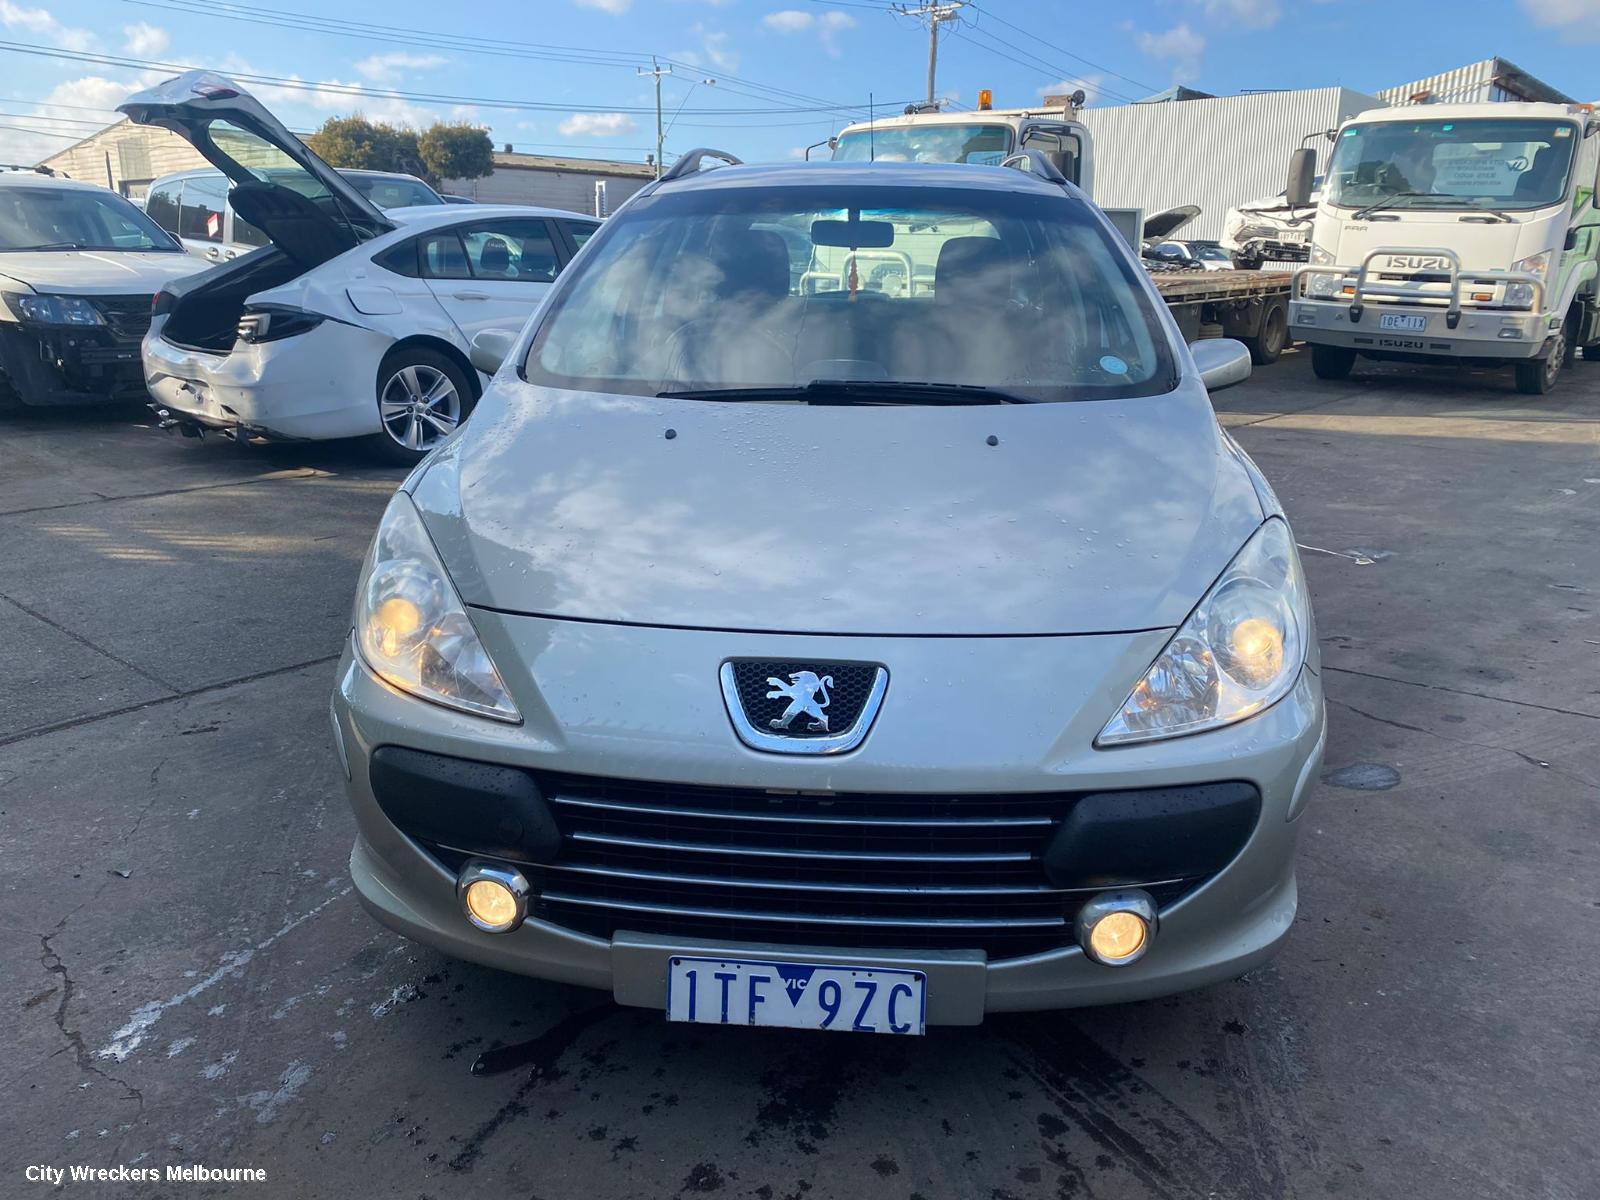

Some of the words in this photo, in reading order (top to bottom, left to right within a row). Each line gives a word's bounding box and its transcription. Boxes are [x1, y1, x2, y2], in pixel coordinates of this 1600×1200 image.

[1387, 256, 1452, 269] ISUZU
[1379, 339, 1424, 349] ISUZU
[782, 977, 807, 990] VIC
